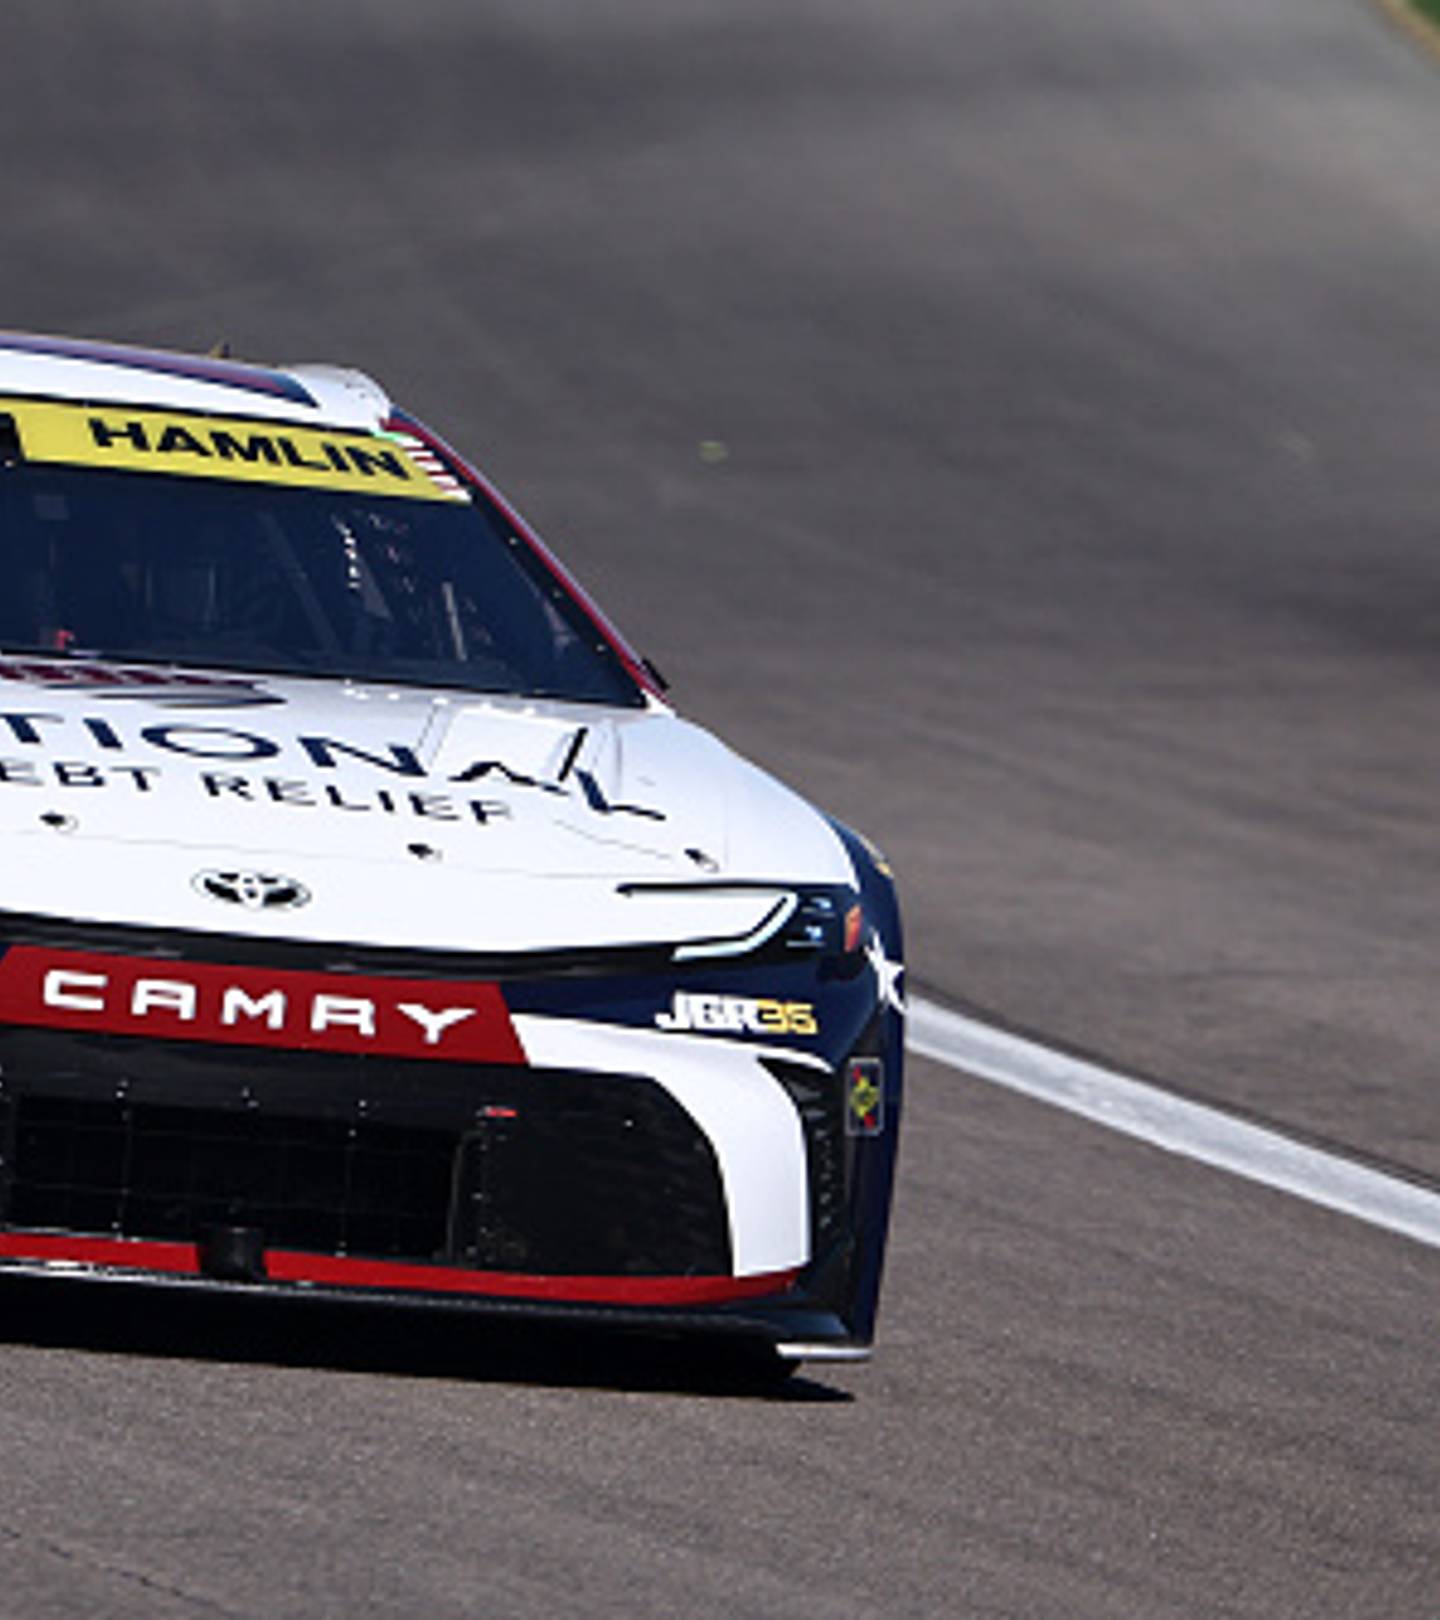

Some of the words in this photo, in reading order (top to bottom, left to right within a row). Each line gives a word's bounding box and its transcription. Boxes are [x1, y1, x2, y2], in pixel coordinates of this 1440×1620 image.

[87, 418, 411, 481] HAMLIN
[200, 771, 514, 826] RELIEF
[43, 969, 477, 1045] CAMRY
